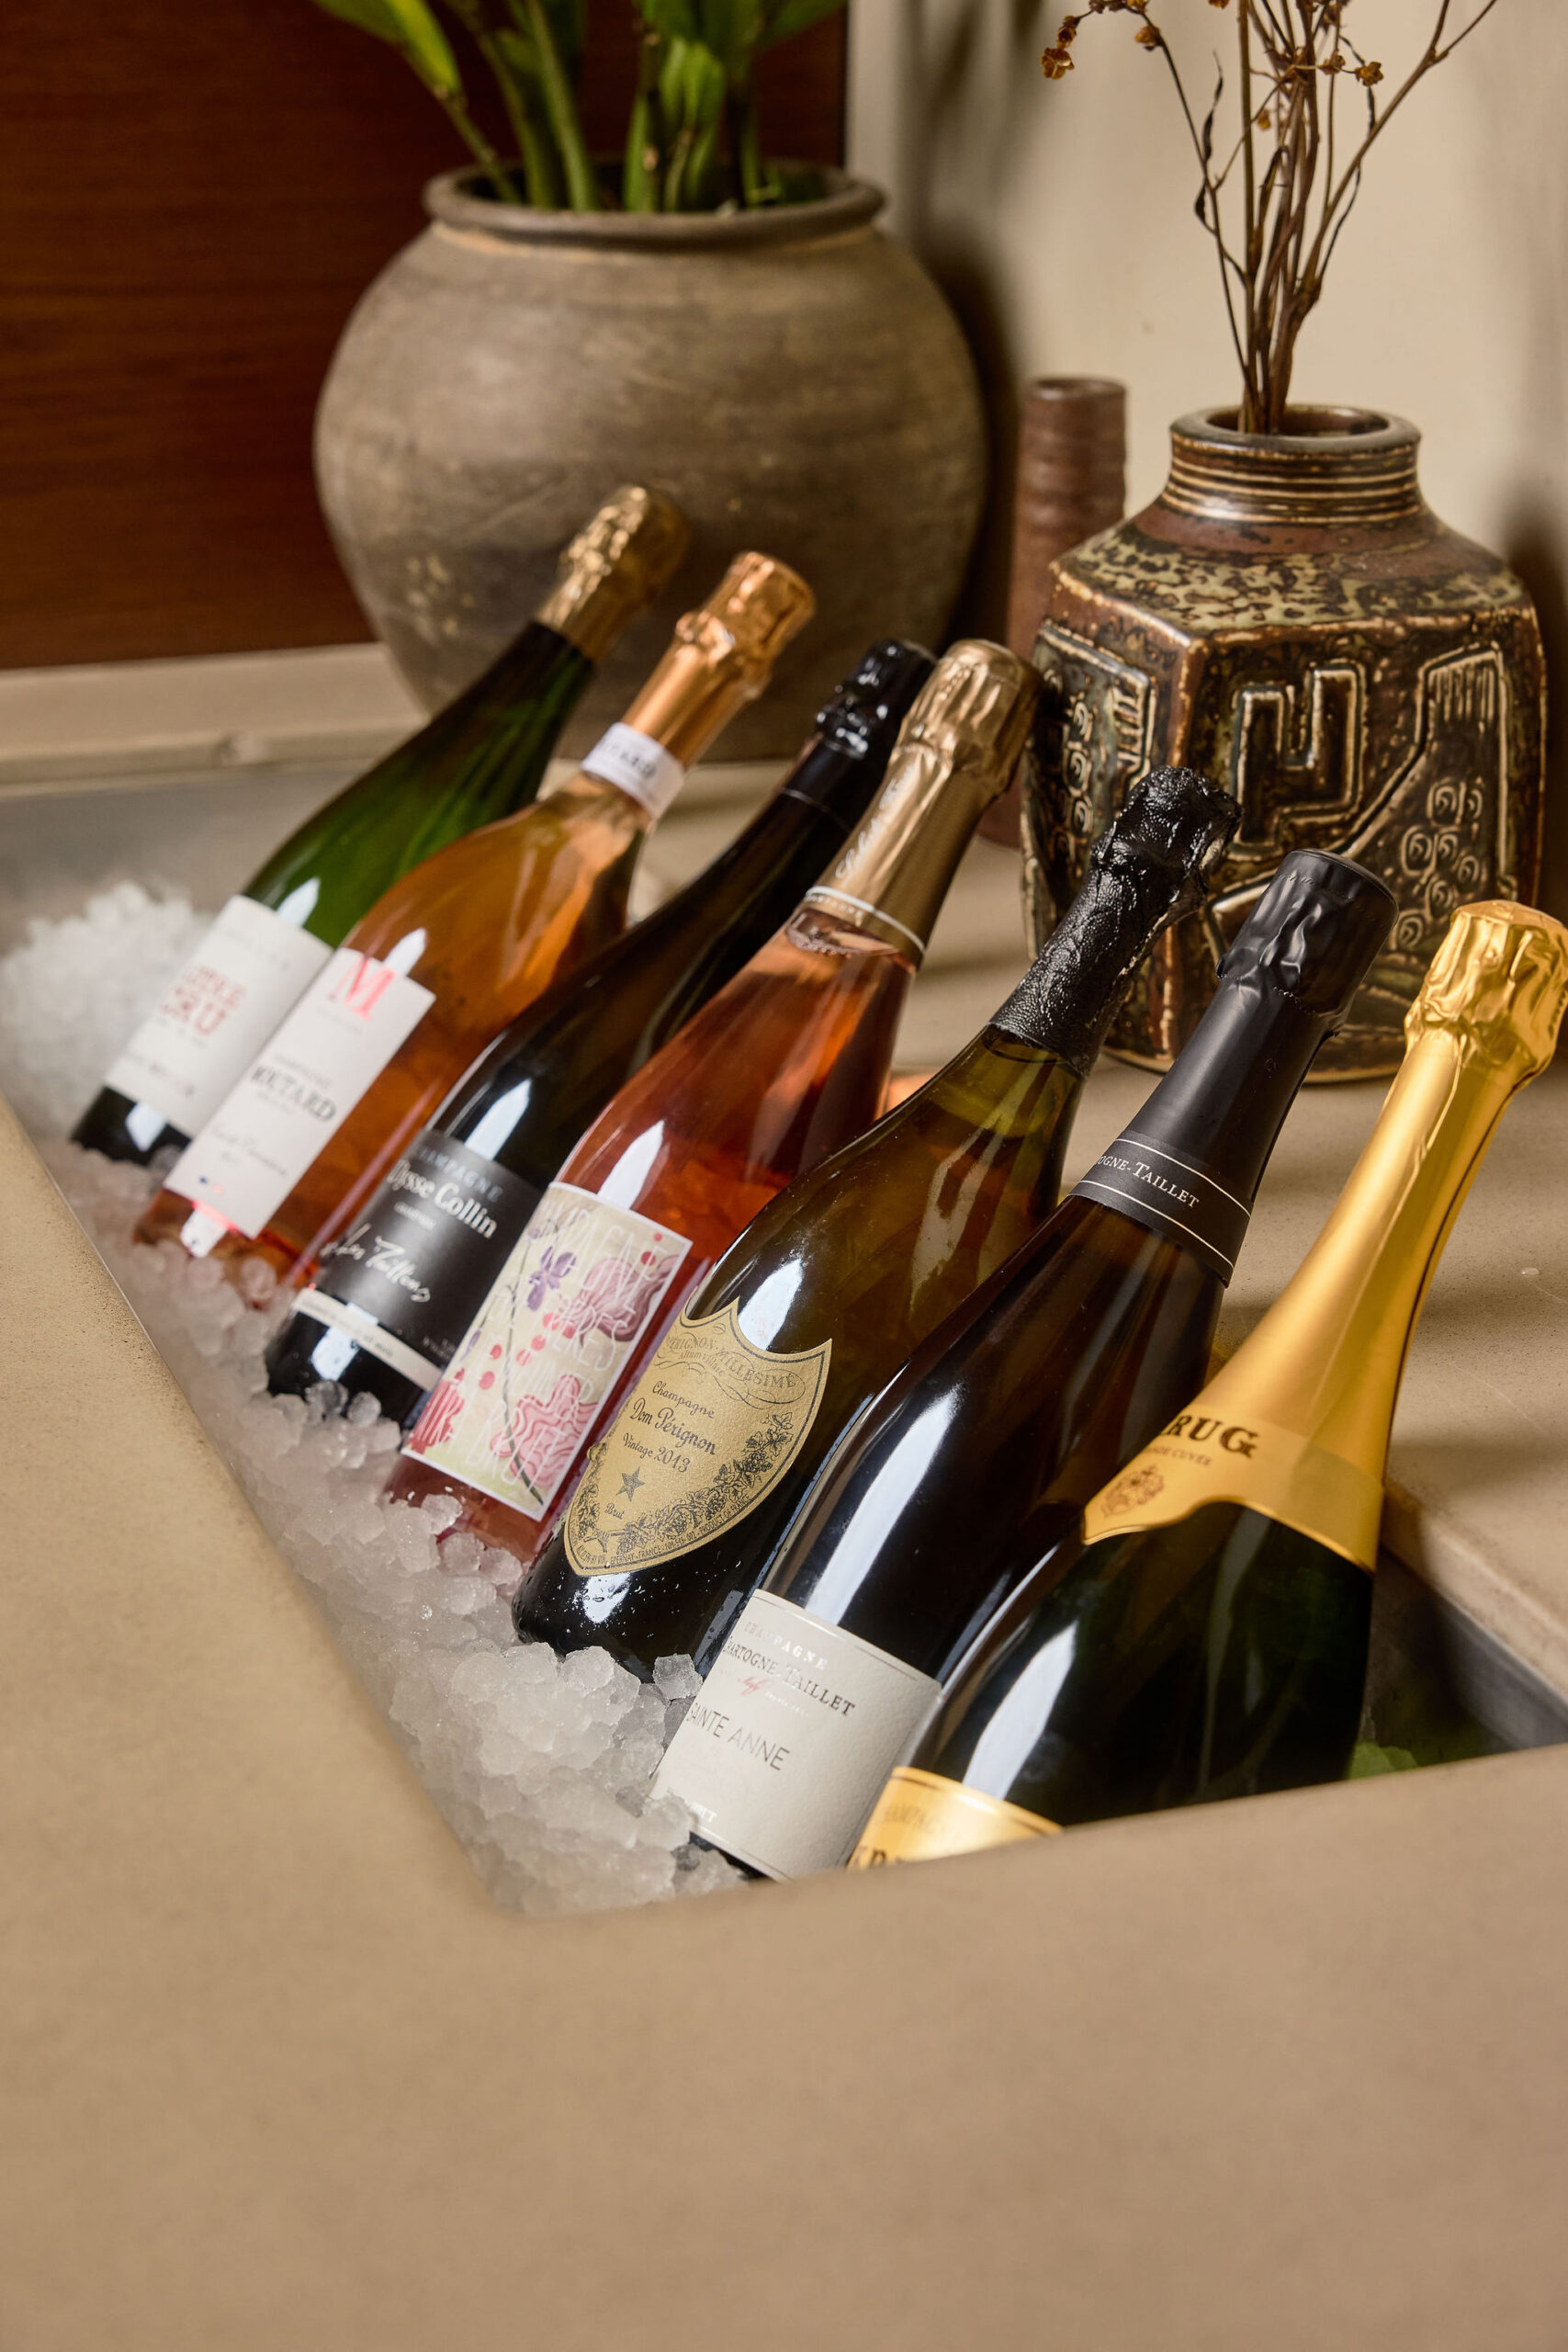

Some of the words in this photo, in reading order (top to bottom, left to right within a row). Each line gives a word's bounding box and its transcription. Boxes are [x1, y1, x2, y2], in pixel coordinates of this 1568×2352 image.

[434, 1182, 498, 1240] Collin
[652, 1380, 715, 1419] Champagne
[630, 1397, 653, 1425] Dom
[654, 1407, 716, 1455] Pérignon
[1160, 1414, 1259, 1460] RUG
[623, 1432, 653, 1459] Vintage
[653, 1446, 691, 1473] 2013
[604, 1502, 625, 1520] Brut
[727, 1726, 790, 1771] ANNE
